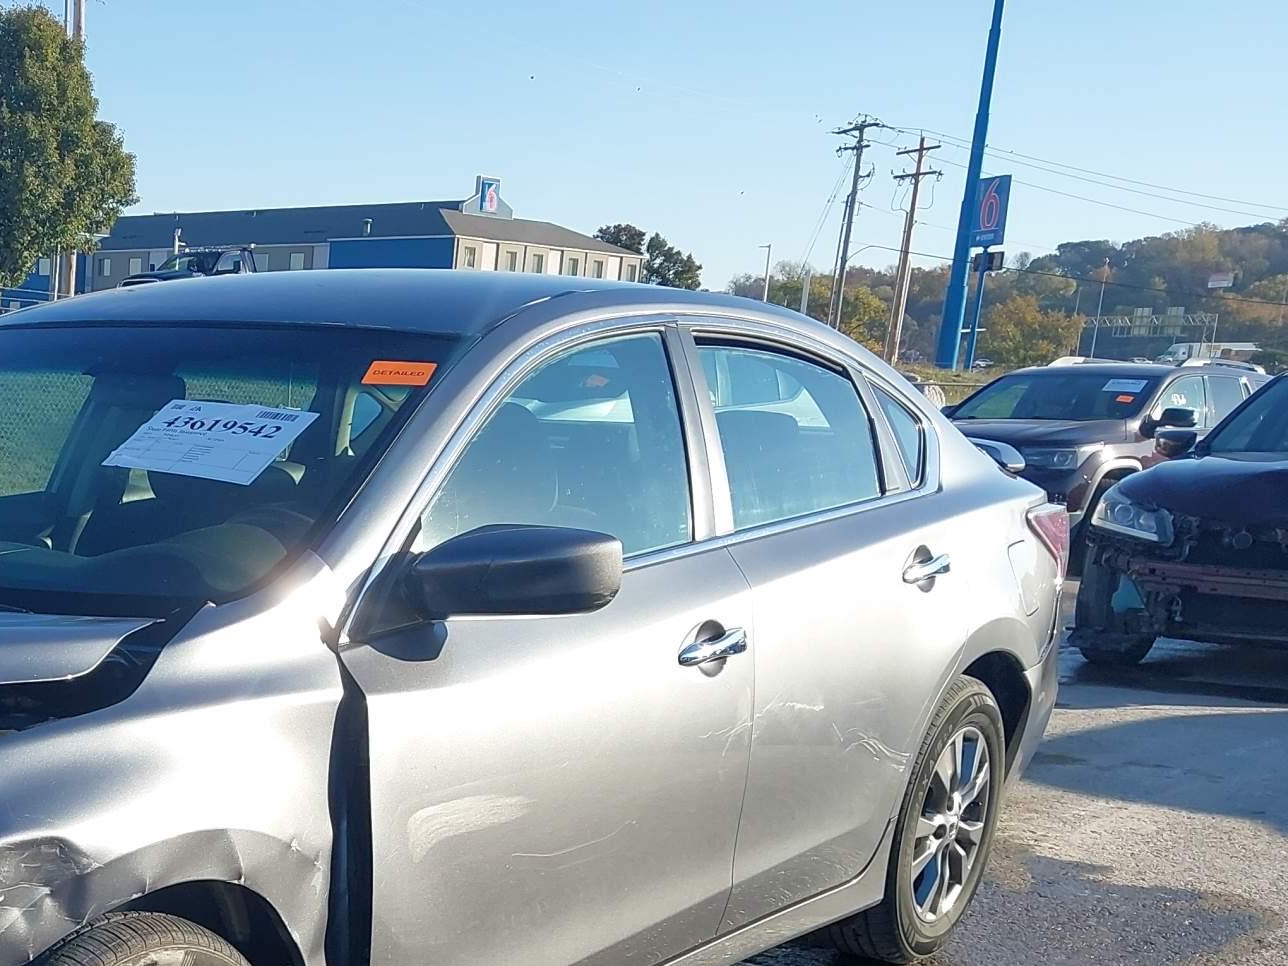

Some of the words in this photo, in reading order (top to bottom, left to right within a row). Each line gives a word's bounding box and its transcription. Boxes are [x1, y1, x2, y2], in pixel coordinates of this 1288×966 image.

[980, 178, 1000, 231] 6
[372, 369, 425, 377] DETAILED
[163, 415, 282, 439] 43619542
